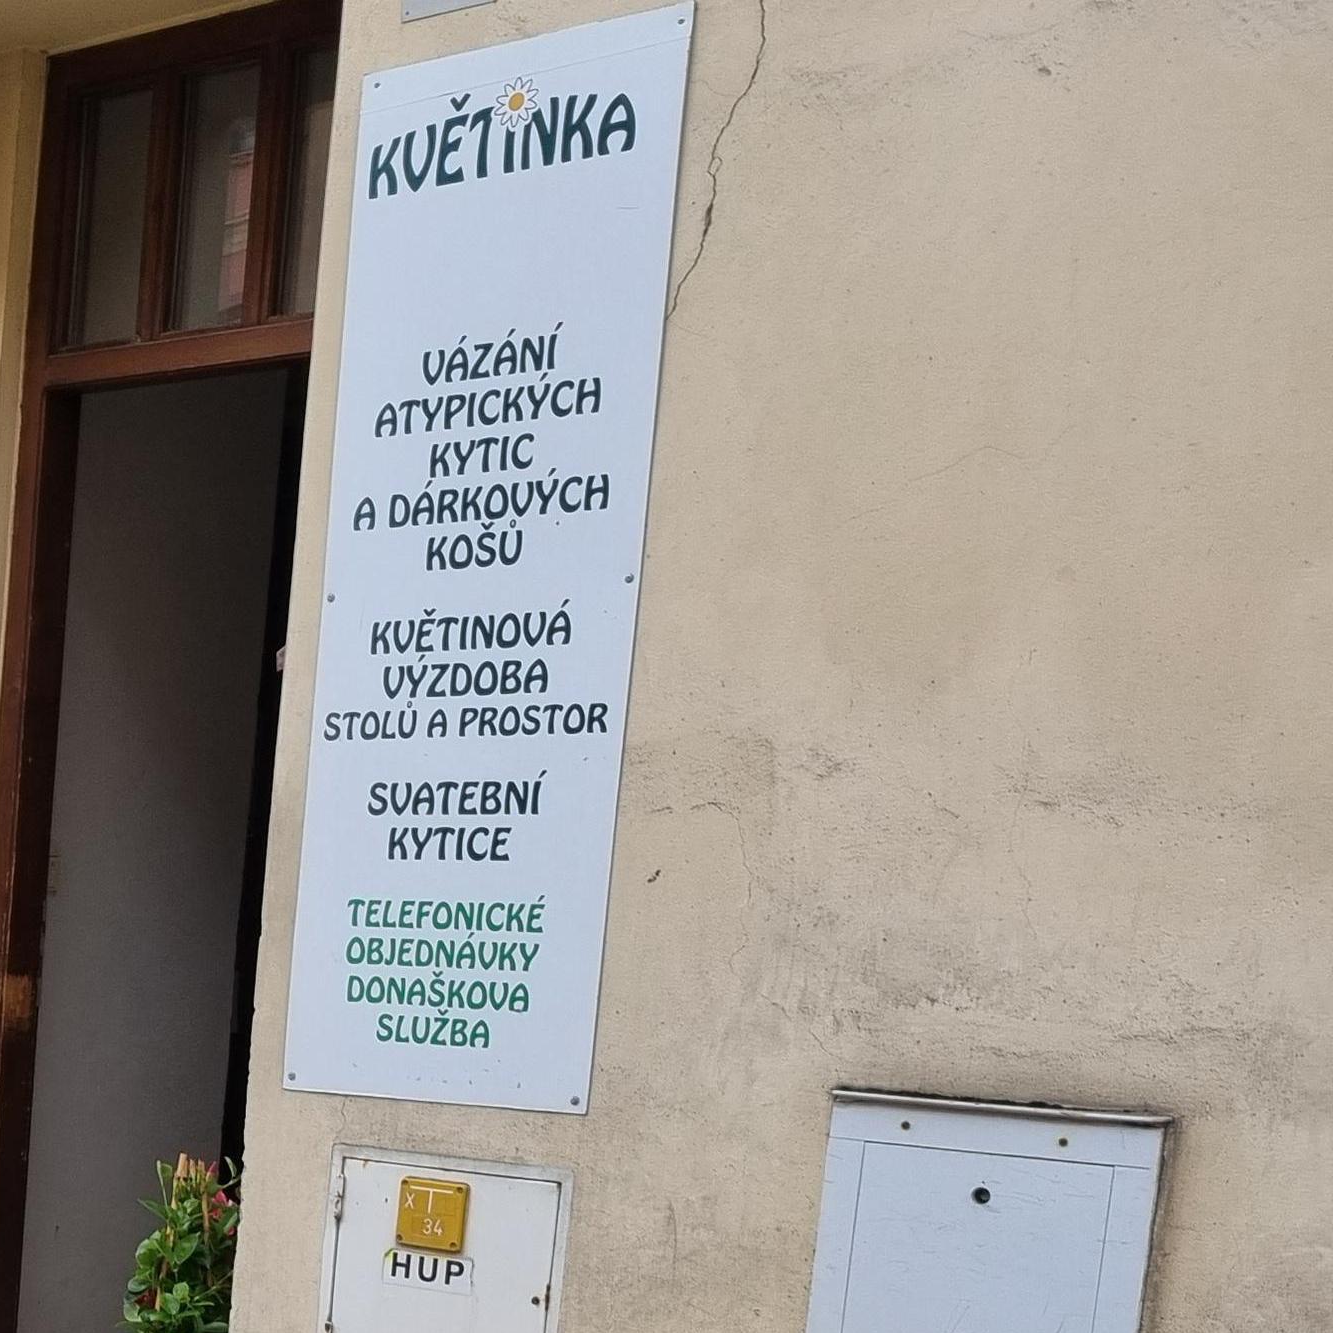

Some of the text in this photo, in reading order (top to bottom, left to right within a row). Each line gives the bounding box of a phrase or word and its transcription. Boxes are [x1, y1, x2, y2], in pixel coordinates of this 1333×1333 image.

[368, 92, 637, 200] KVĚTINKA
[422, 321, 564, 386] VÁZÁNÍ
[374, 372, 602, 437] ATYPICKÝCH
[429, 432, 535, 478] KYTIC
[353, 468, 610, 532] A DÁRKOVÝCH
[425, 518, 523, 572] KOŠŮ
[370, 598, 572, 655] KVĚTINOVÁ
[383, 653, 549, 700] VÝZDOBA
[323, 700, 609, 742] STOLŮ A PROSTOR
[367, 769, 545, 817] SVATEBNÍ
[387, 826, 513, 862] KYTICE
[347, 894, 546, 934] TELEFONICKÉ
[345, 931, 540, 972] OBJEDNÁVKY
[346, 970, 530, 1014] DONAŠKOVA
[376, 1008, 490, 1049] SLUŽBA
[422, 1218, 443, 1236] 34
[390, 1252, 465, 1286] HUP
